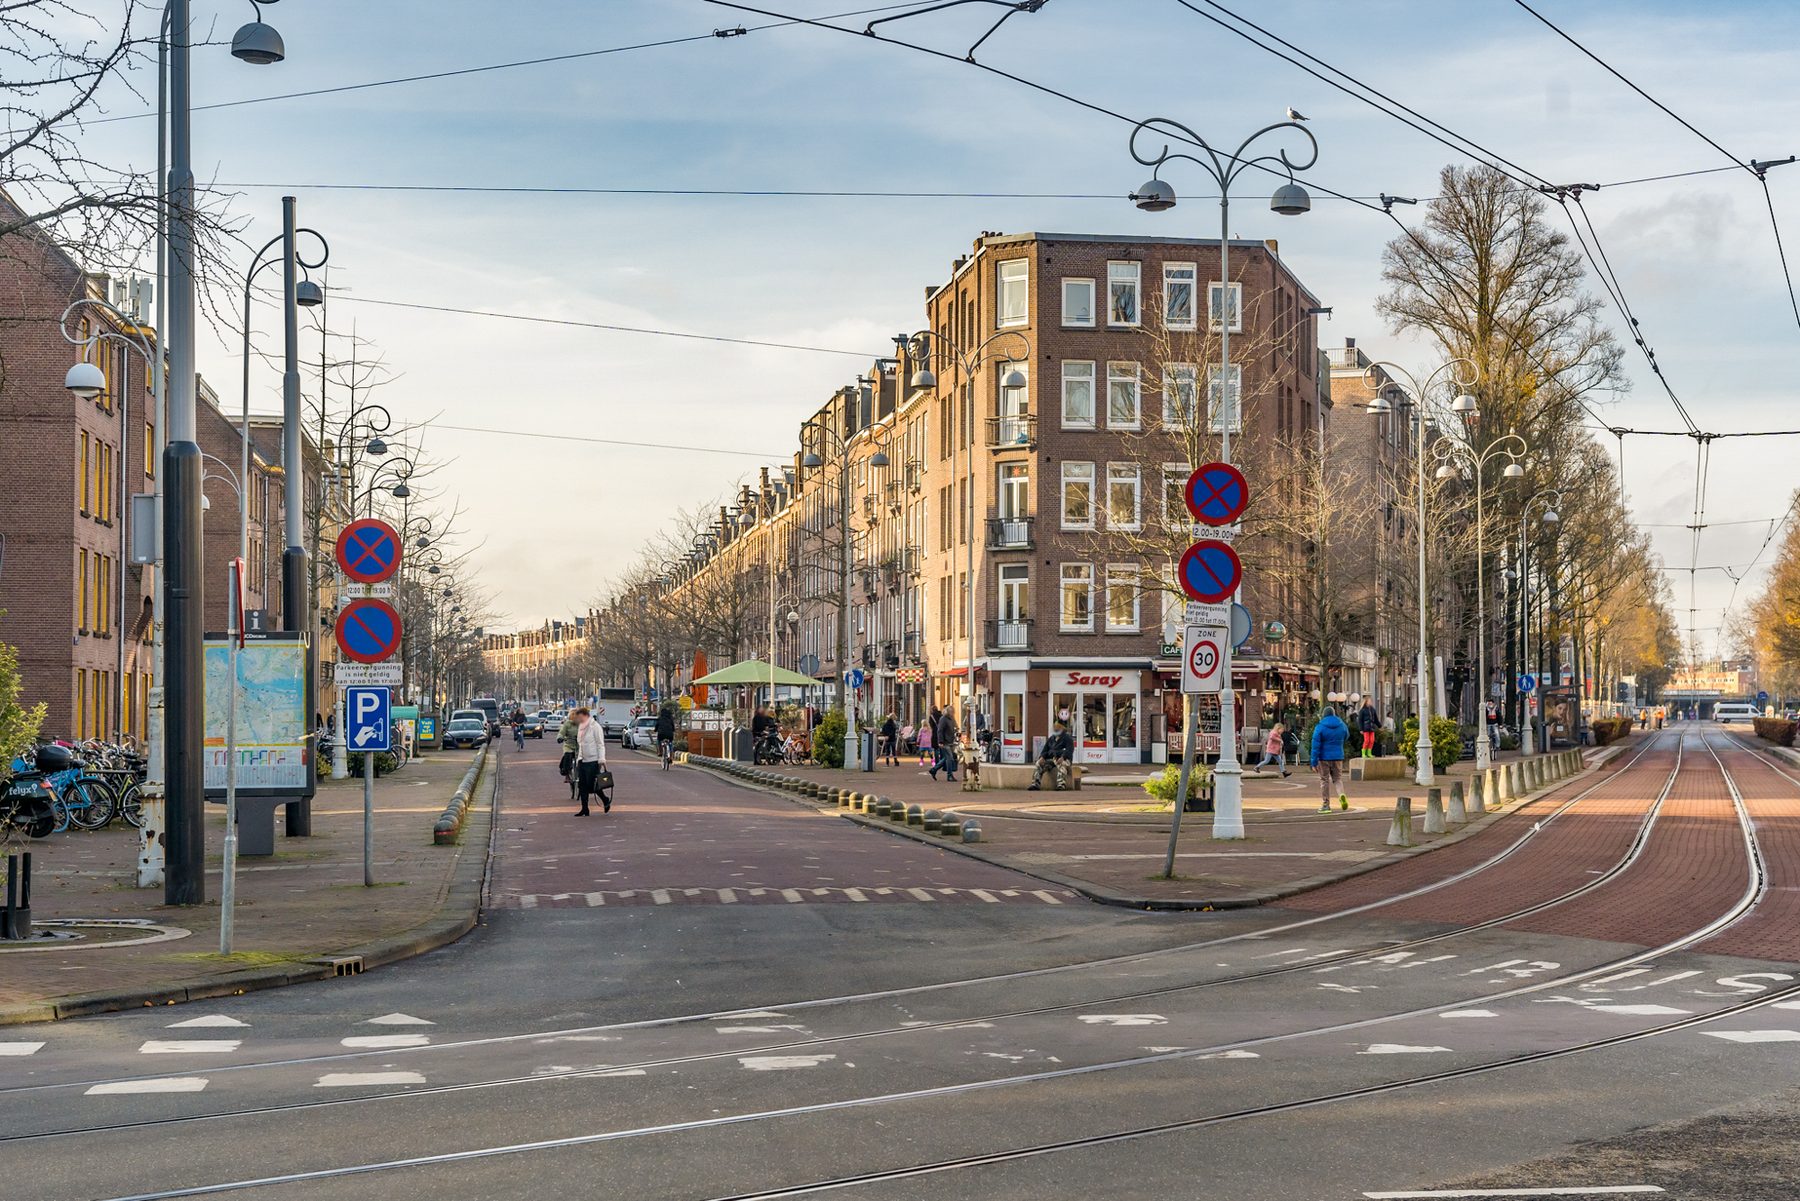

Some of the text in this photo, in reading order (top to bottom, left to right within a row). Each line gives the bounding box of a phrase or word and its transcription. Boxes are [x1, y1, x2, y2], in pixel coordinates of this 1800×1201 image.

[1195, 652, 1213, 666] 30
[335, 664, 401, 672] Parkeervergunning
[1067, 671, 1122, 687] Saray
[356, 692, 380, 724] P
[9, 786, 32, 796] felyx
